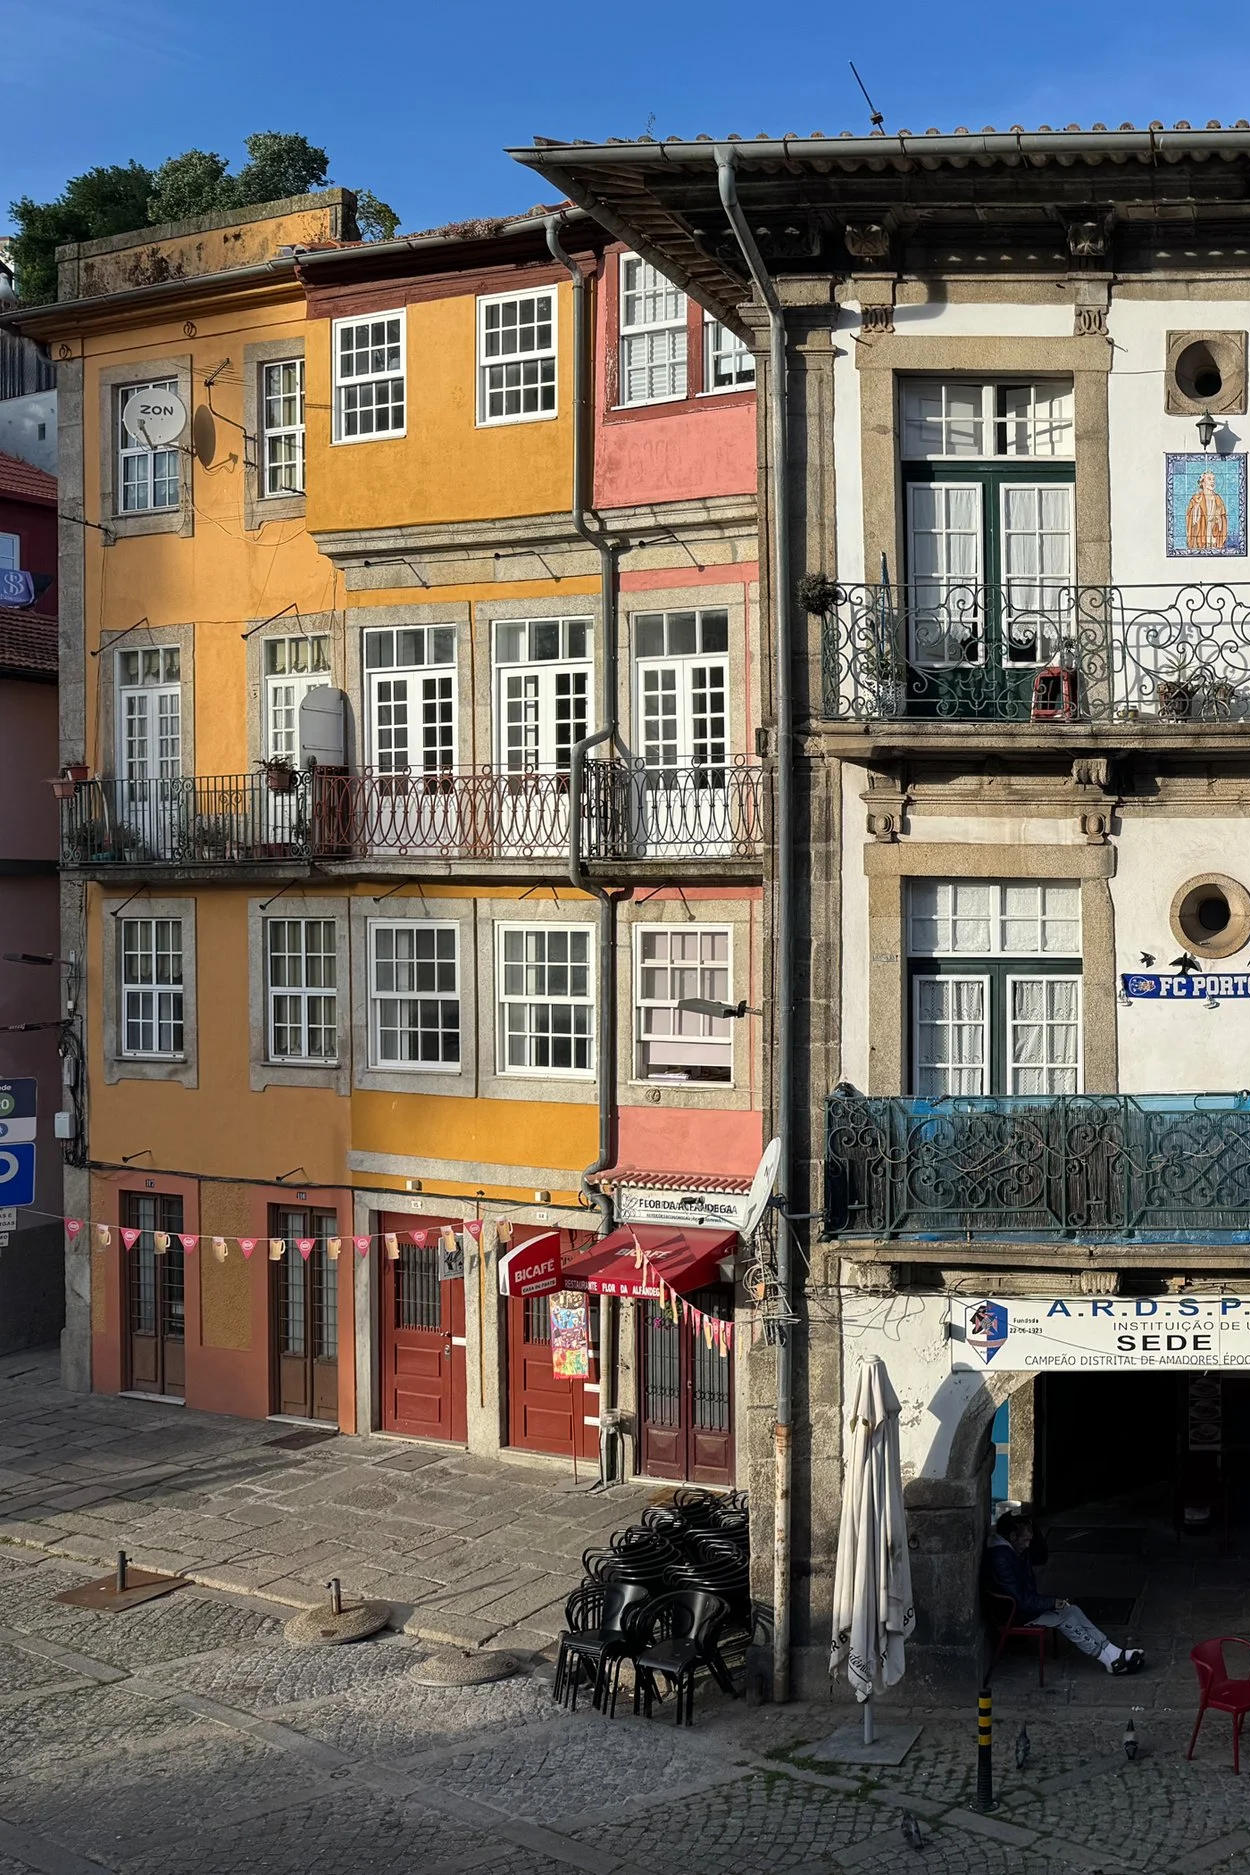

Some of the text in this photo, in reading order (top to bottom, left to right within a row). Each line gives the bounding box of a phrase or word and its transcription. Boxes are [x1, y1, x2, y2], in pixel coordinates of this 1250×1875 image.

[140, 405, 173, 415] ZON
[1159, 977, 1186, 996] FC
[564, 1280, 598, 1291] RESTAURANTE
[602, 1283, 616, 1293] FLOR
[620, 1285, 629, 1293] DA
[1113, 1320, 1214, 1332] INSTITUIÇÃO
[1220, 1321, 1241, 1330] DE
[1117, 1335, 1212, 1351] SEDE
[1025, 1353, 1076, 1366] CAMPEÃO
[1080, 1355, 1137, 1365] DISTRITAL
[1141, 1356, 1155, 1364] DE
[1159, 1354, 1219, 1365] AMADORES
